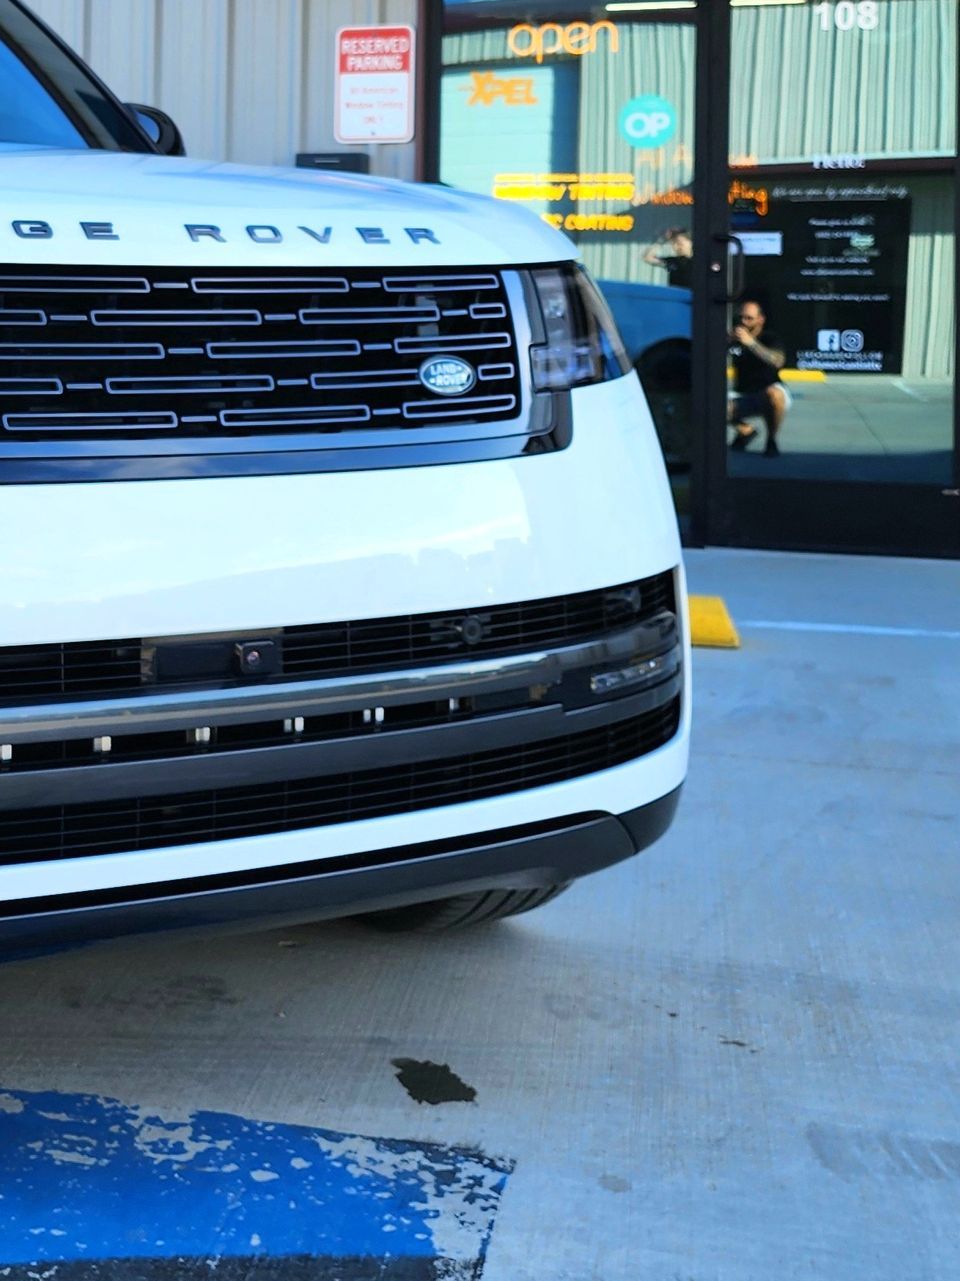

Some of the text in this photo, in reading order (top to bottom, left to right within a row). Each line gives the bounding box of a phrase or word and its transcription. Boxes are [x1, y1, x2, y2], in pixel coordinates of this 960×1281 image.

[813, 0, 879, 31] 108
[341, 36, 410, 55] RESERVED
[507, 20, 619, 64] open
[346, 54, 404, 72] PARKING
[183, 222, 441, 245] ROVER
